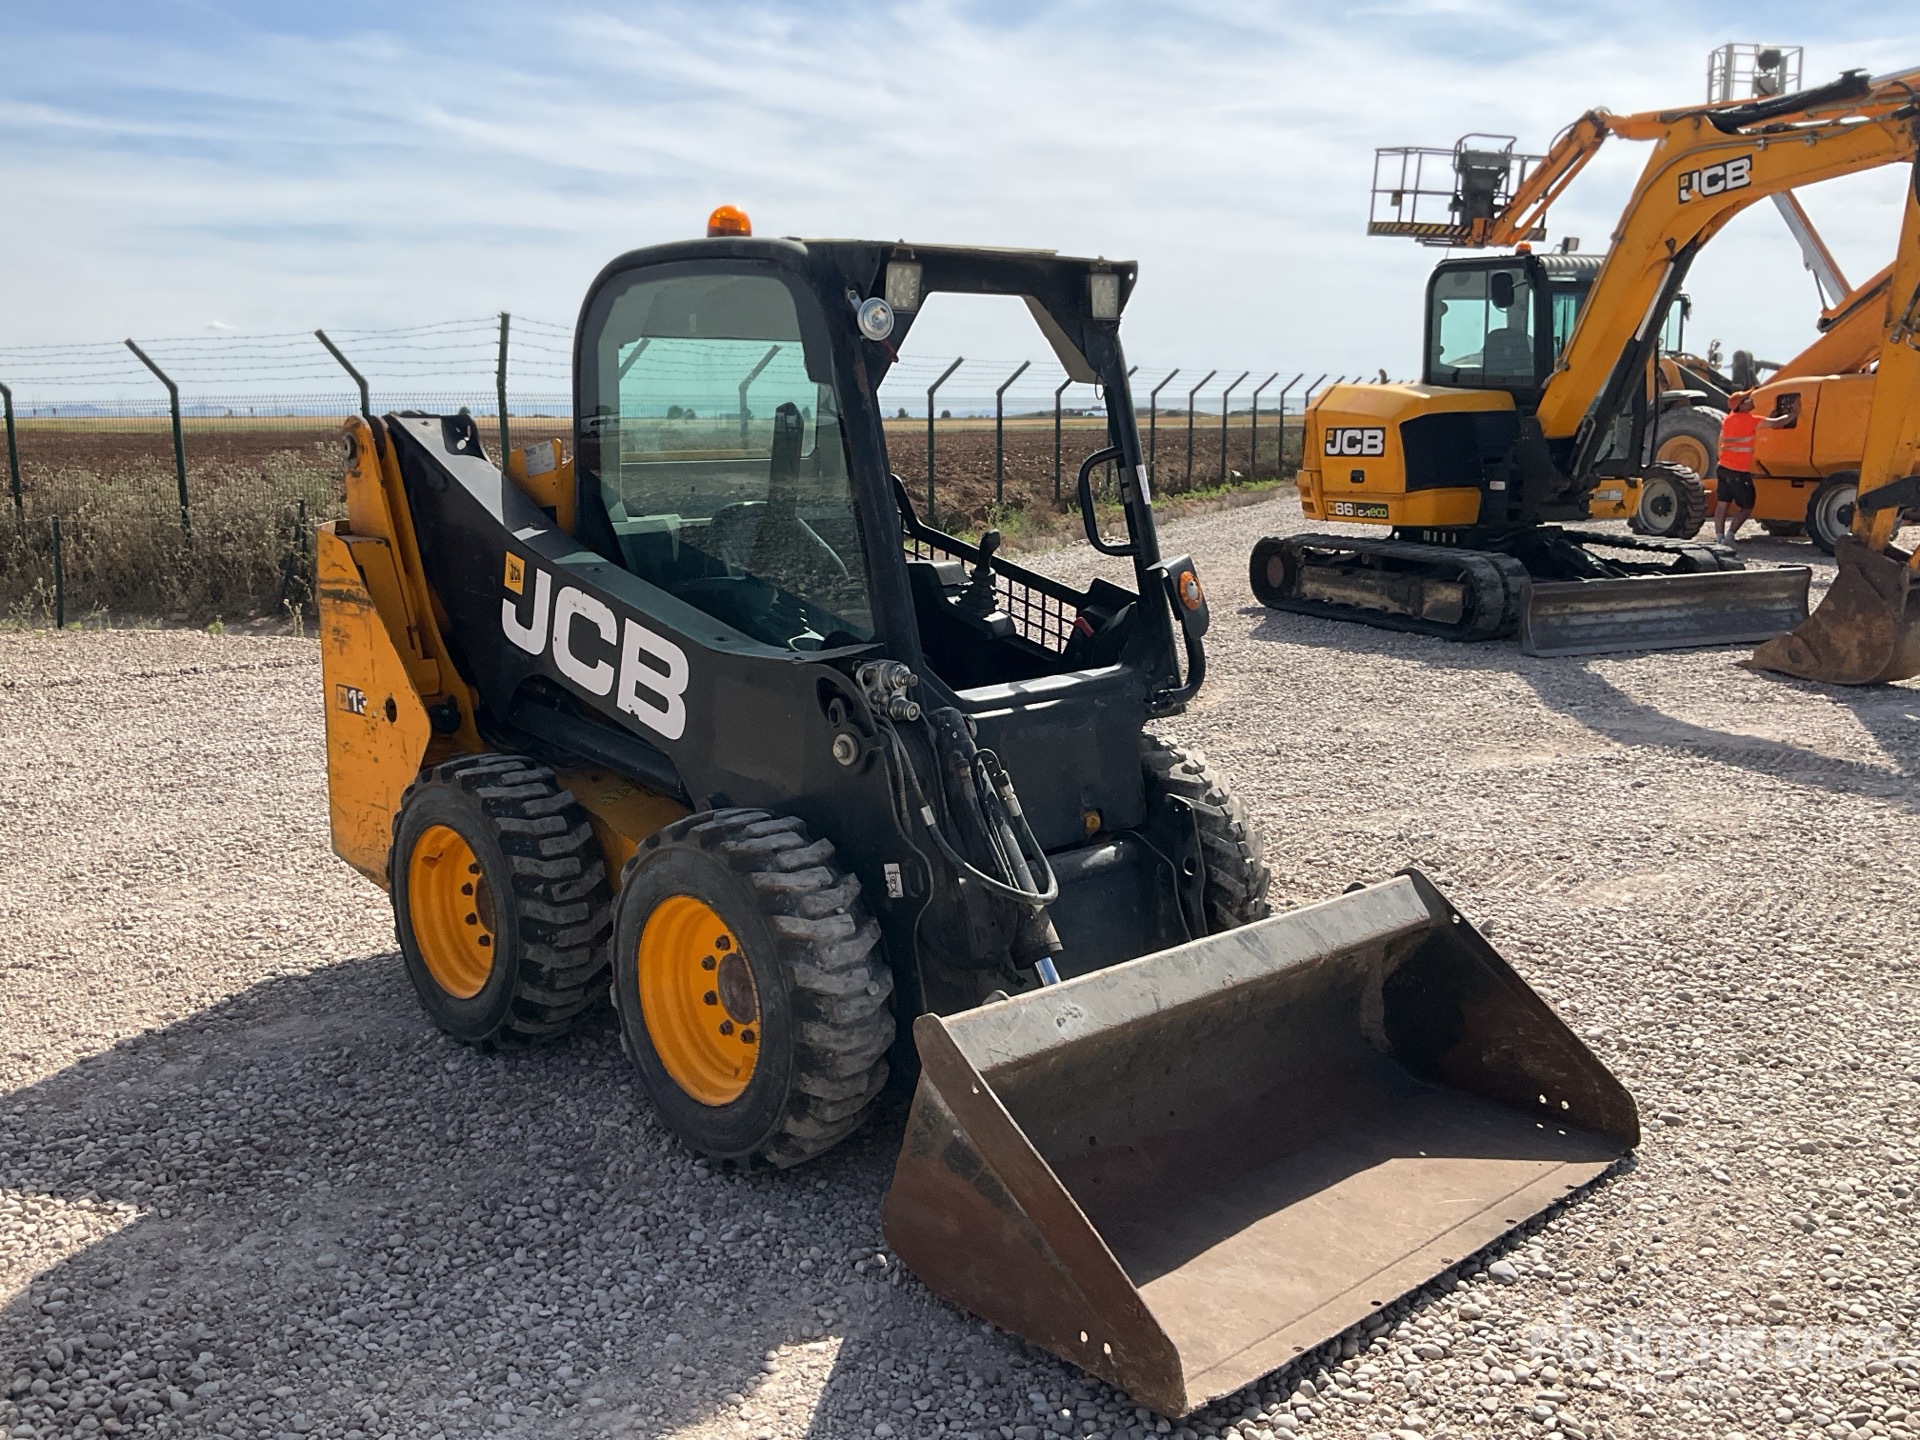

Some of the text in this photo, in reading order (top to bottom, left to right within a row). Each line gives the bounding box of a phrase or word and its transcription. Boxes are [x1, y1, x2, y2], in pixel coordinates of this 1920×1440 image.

[1680, 158, 1751, 201] JCB
[1326, 429, 1384, 455] JCB
[1335, 502, 1354, 516] 86
[502, 568, 690, 740] JCB
